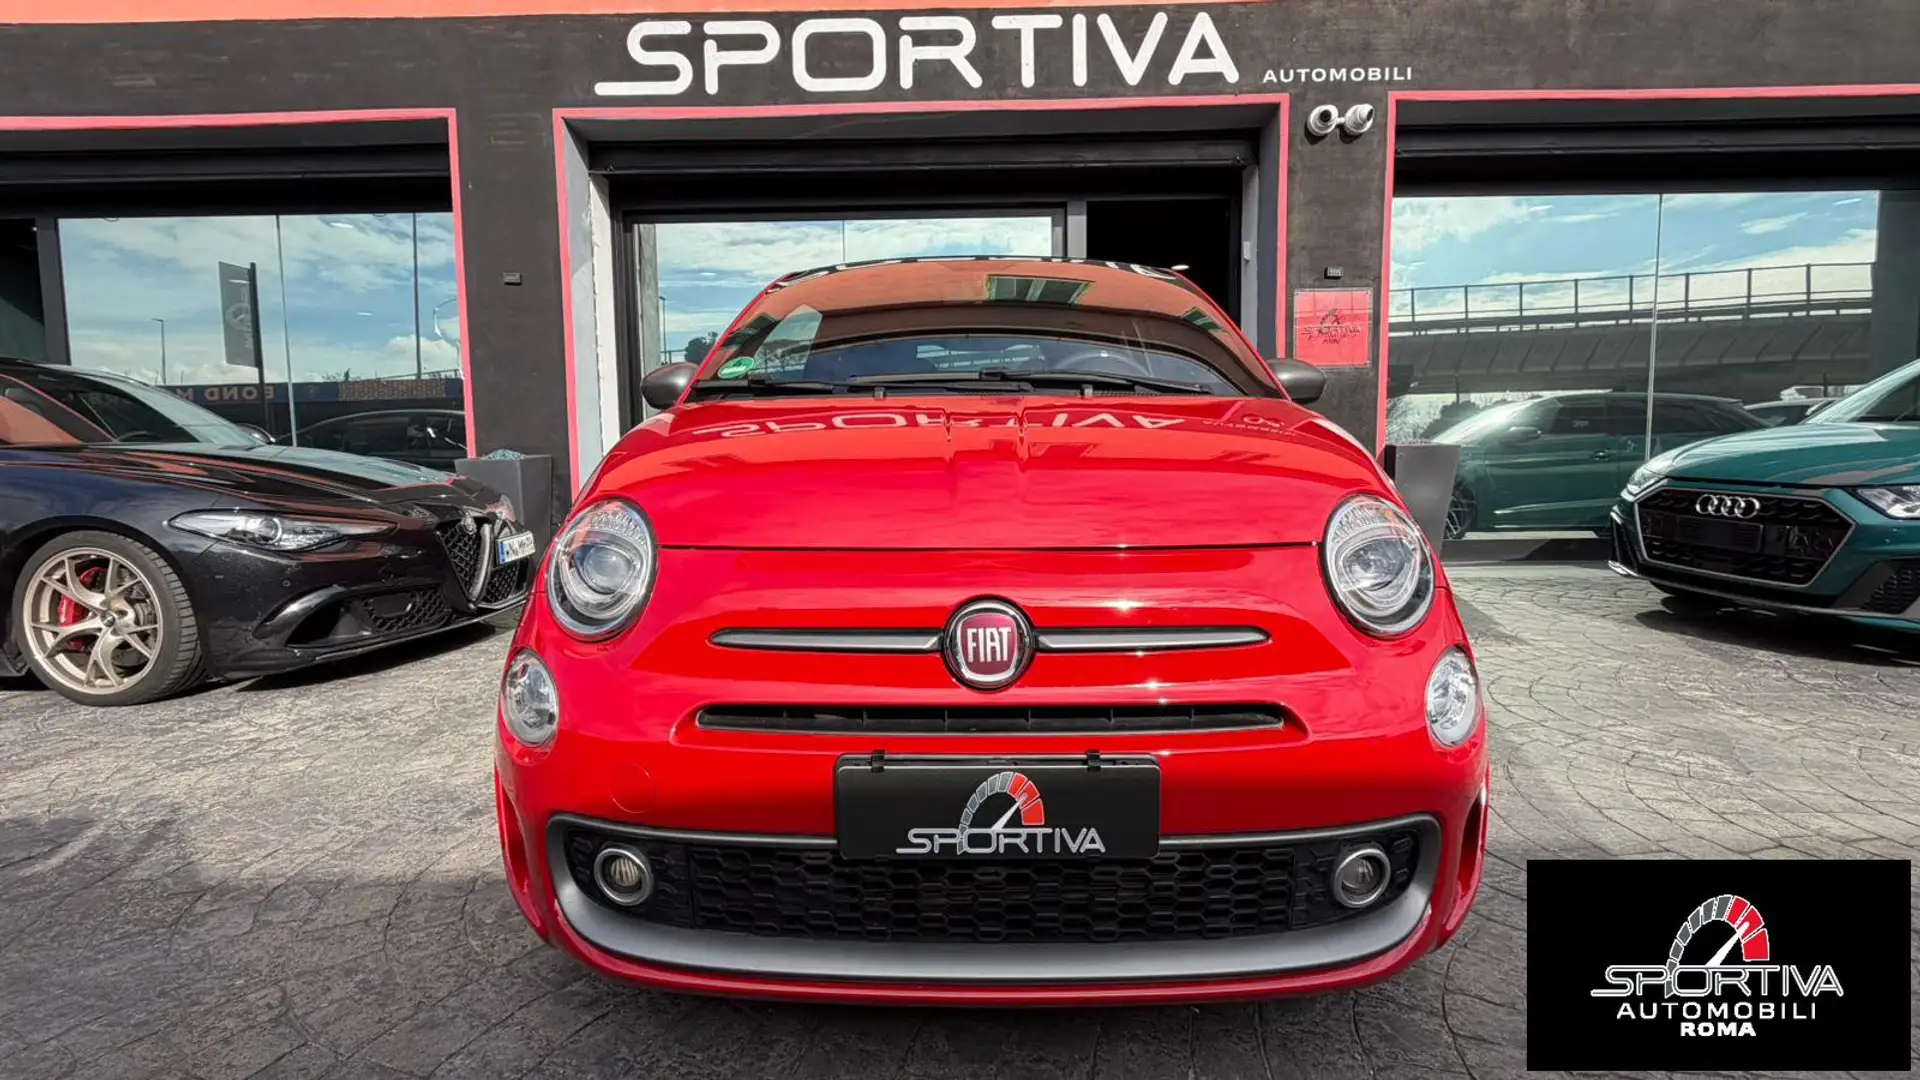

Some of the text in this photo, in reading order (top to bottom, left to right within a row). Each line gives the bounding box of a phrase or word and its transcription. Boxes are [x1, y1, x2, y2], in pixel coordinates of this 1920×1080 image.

[595, 12, 1240, 95] SPORTIVA
[1262, 66, 1412, 84] AUTOMOBILI
[967, 627, 1011, 662] FIAT
[896, 828, 1106, 854] SPORTIVA
